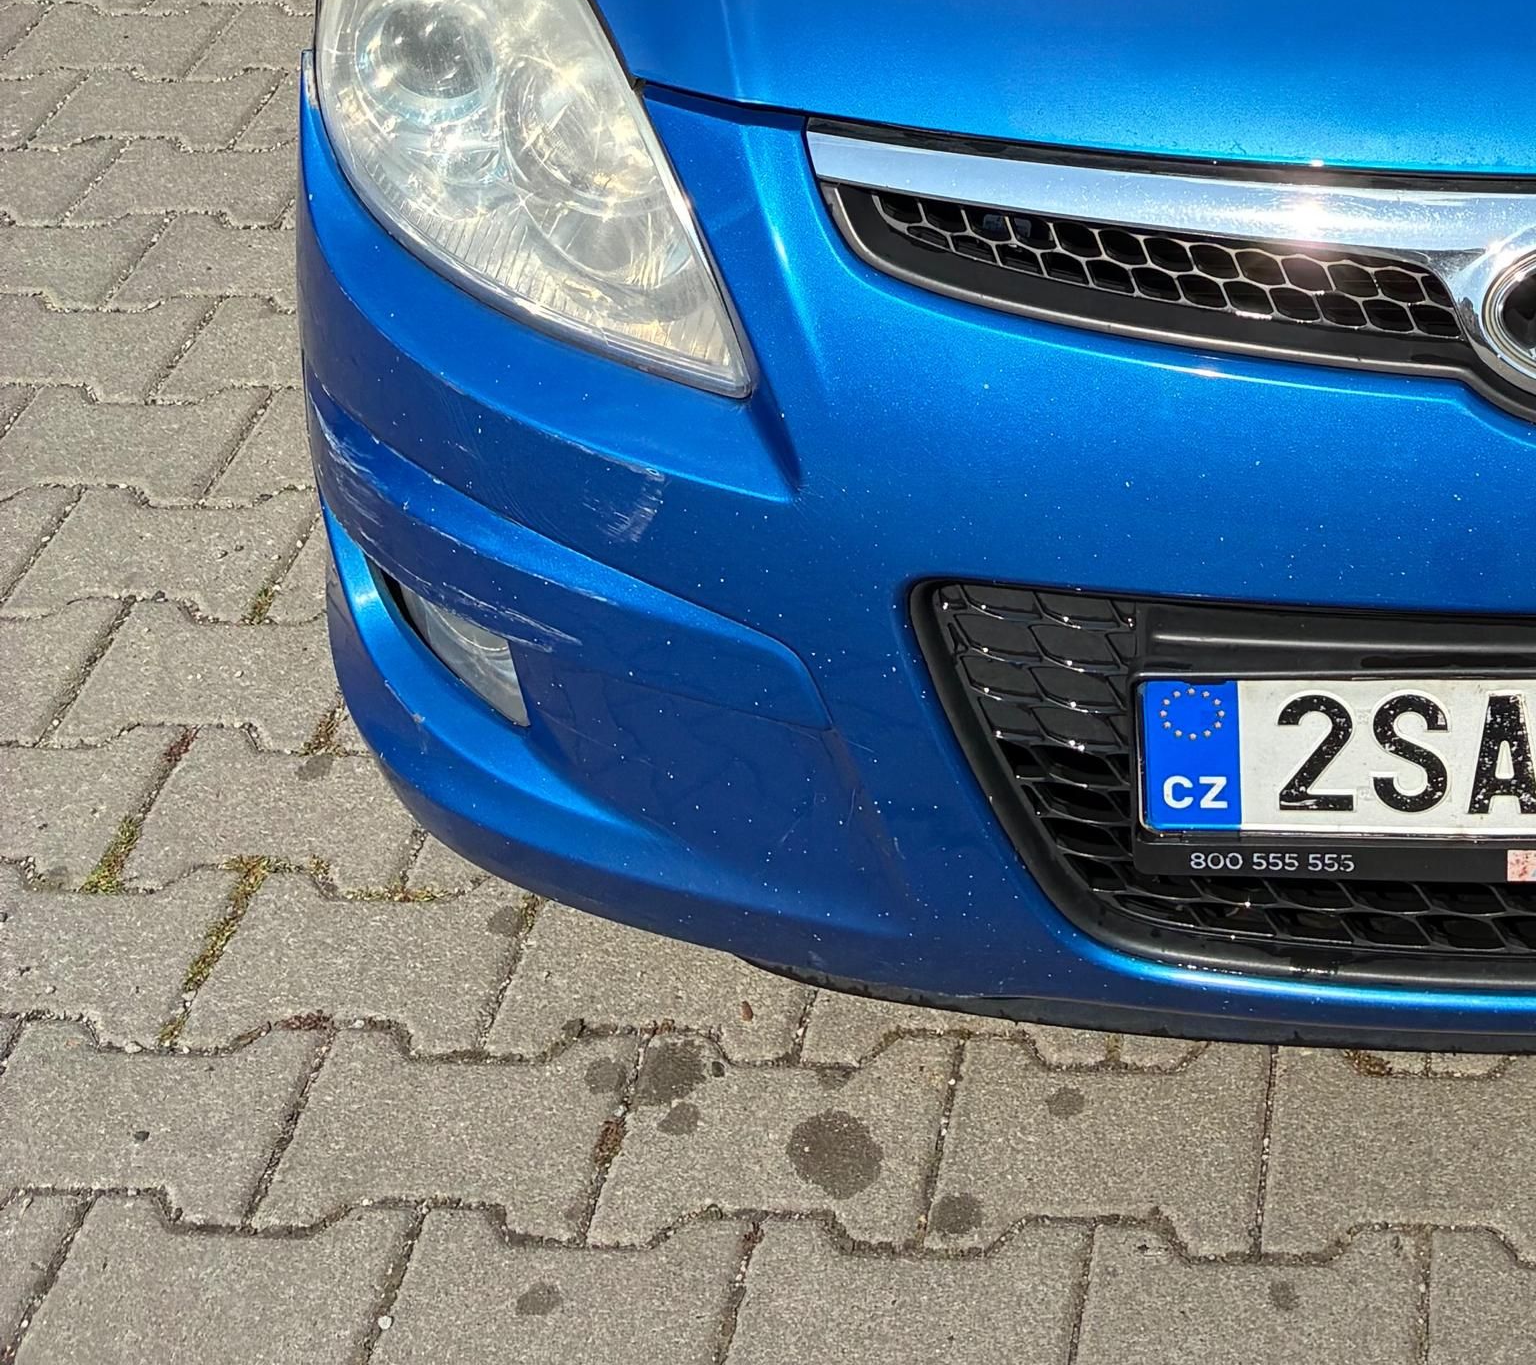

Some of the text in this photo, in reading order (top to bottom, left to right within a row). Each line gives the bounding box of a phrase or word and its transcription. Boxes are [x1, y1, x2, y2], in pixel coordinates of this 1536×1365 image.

[1162, 775, 1229, 810] CZ
[1189, 852, 1355, 872] 800 555 555
